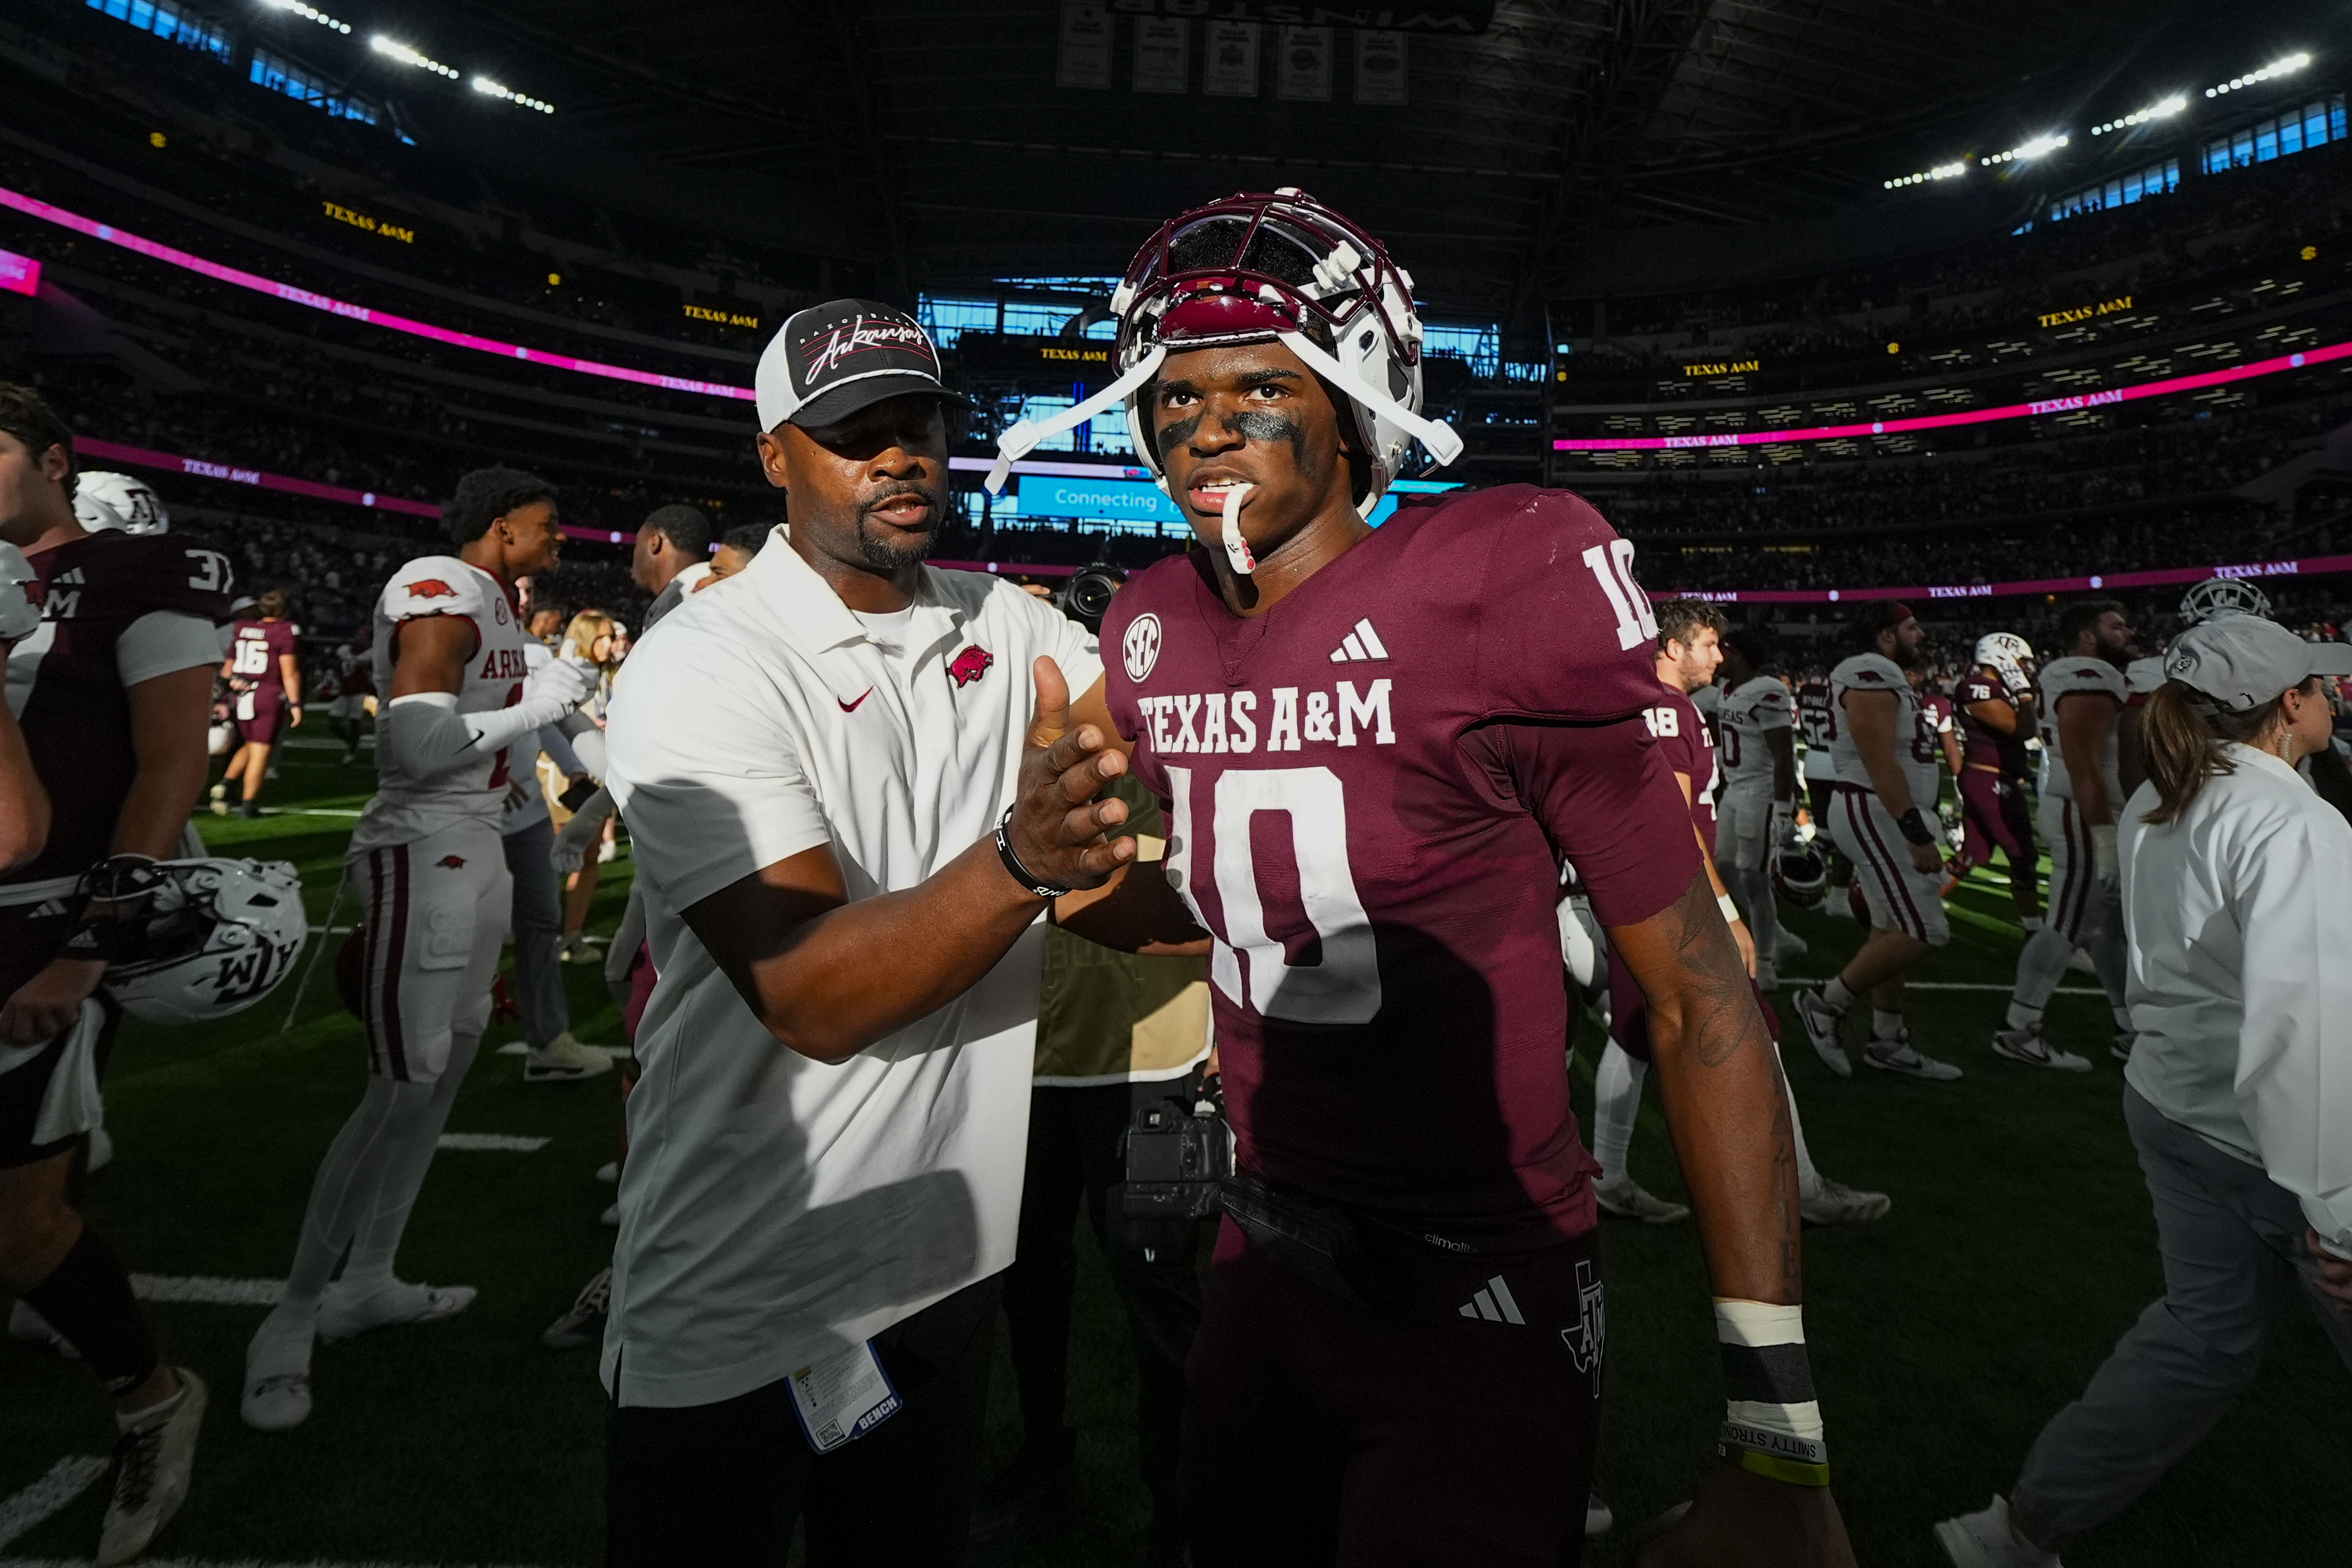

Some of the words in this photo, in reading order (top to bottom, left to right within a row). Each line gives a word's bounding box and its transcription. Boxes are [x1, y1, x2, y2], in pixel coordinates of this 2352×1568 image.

[322, 201, 376, 231] TEXAS
[683, 304, 727, 323] TEXAS
[2038, 306, 2092, 327] TEXAS
[2096, 296, 2132, 316] A&M
[1040, 348, 1079, 360] TEXAS
[1683, 363, 1727, 376] TEXAS
[1730, 360, 1759, 373] A&M
[659, 375, 704, 393] TEXAS
[2028, 396, 2083, 415] TEXAS
[1664, 436, 1706, 448] TEXAS
[1055, 488, 1157, 511] Connecting
[2213, 565, 2262, 579] TEXAS
[1928, 586, 1967, 597] TEXAS
[1127, 615, 1159, 678] SEC
[232, 639, 269, 675] 16
[1969, 684, 1991, 699] 76
[1137, 693, 1257, 753] TEXAS
[1266, 679, 1396, 752] A&M
[1164, 765, 1382, 1025] 10
[858, 1397, 898, 1430] BENCH
[1722, 1426, 1766, 1446] STRON
[1771, 1436, 1816, 1458] SMITTY
